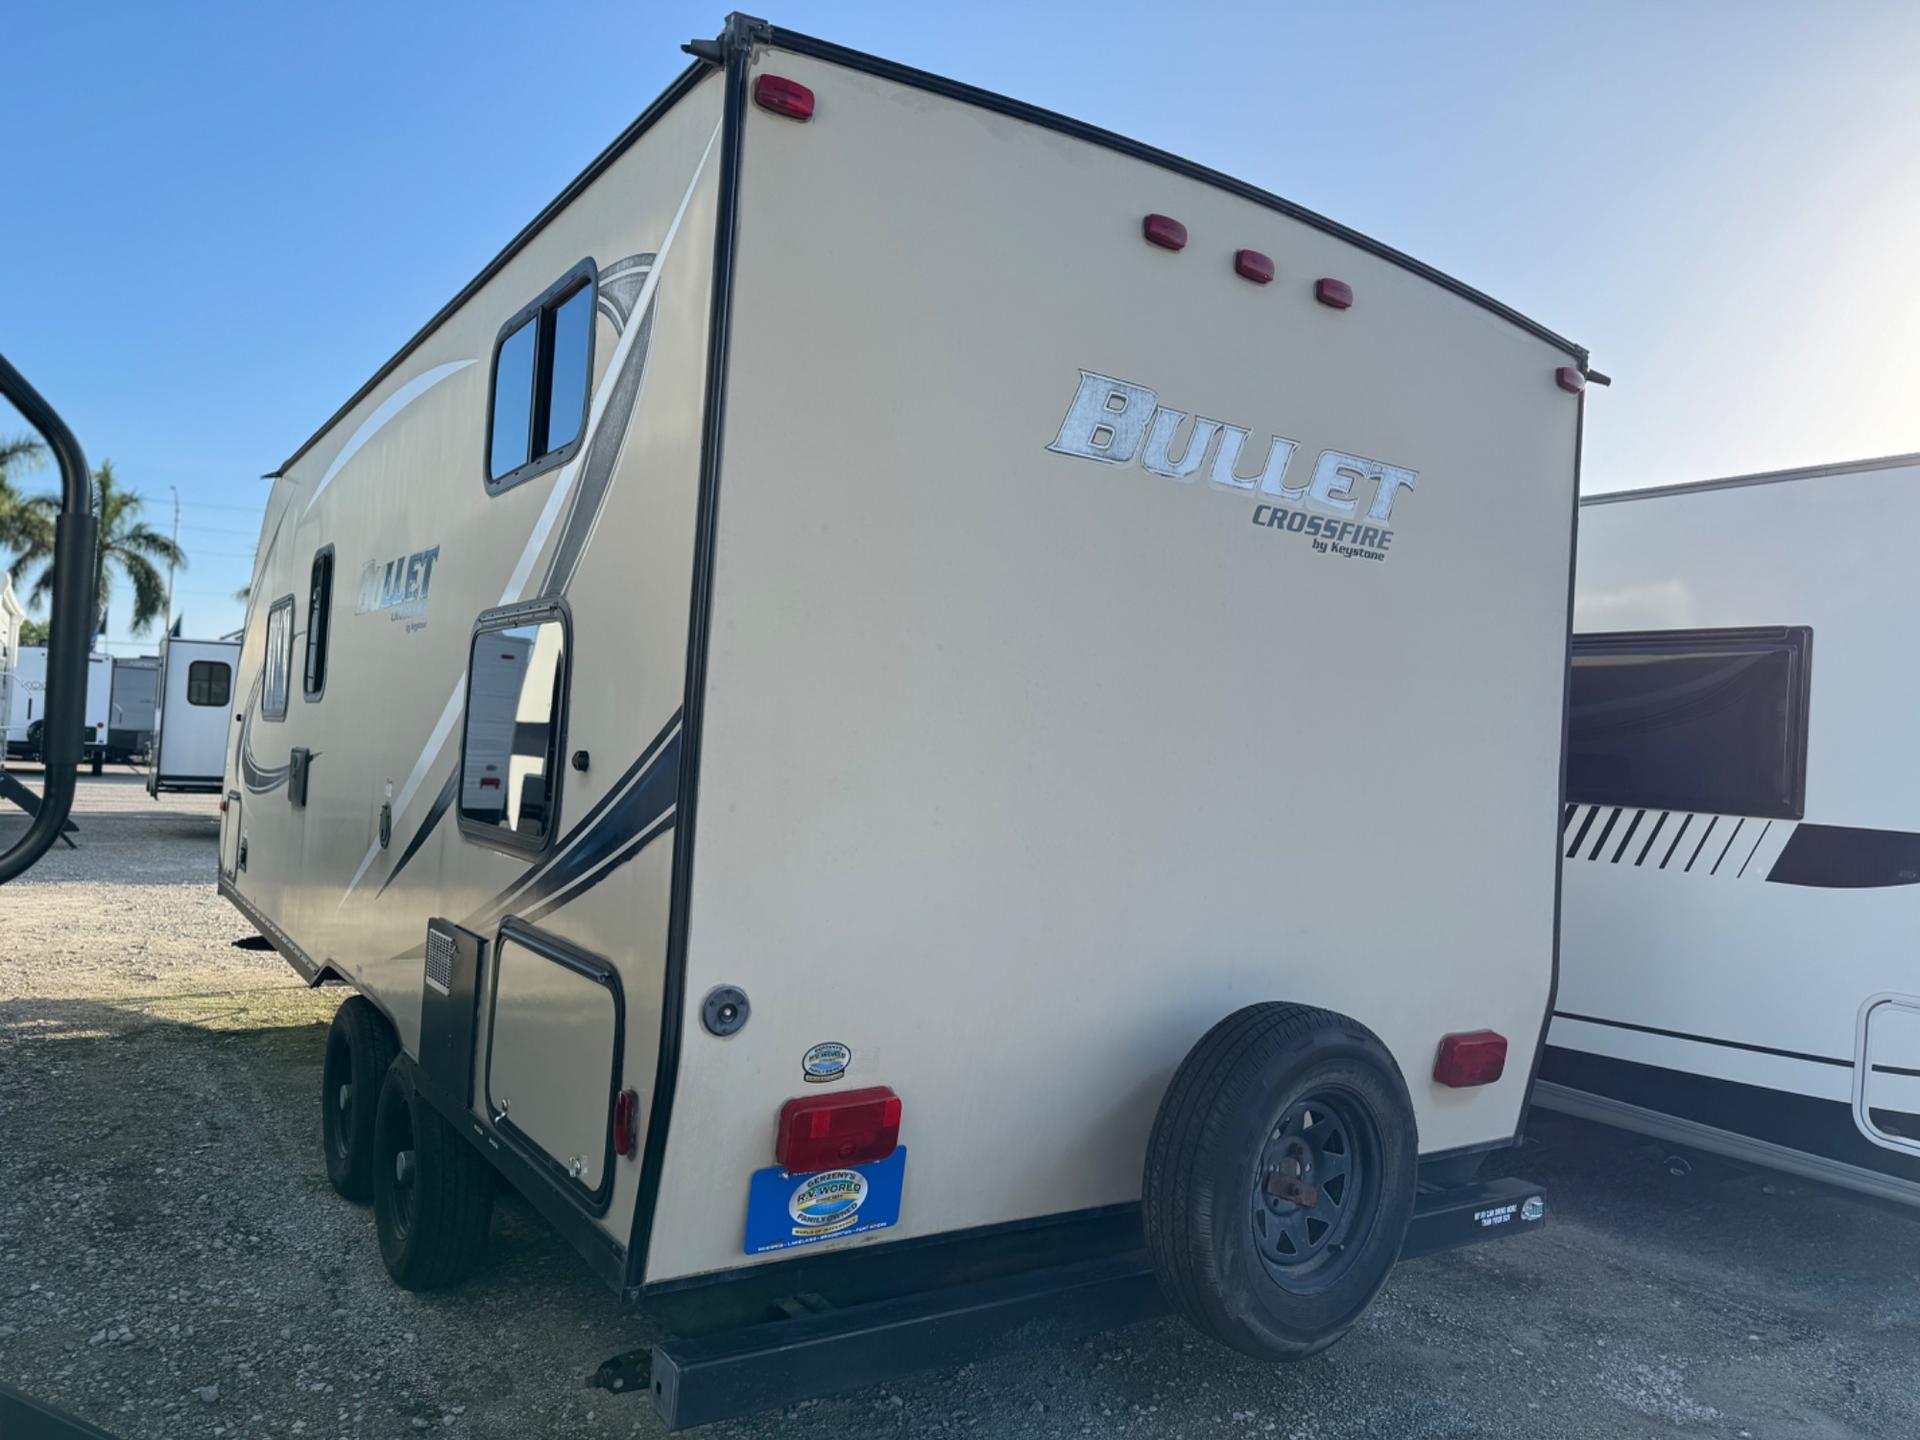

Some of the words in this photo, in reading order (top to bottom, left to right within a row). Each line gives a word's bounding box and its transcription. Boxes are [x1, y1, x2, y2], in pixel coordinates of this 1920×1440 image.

[1044, 367, 1419, 525] BULLET
[1252, 504, 1394, 551] CROSSFIRE
[1312, 538, 1328, 554] by
[1330, 541, 1385, 562] Keystone
[819, 1183, 862, 1196] WORLD
[796, 1212, 827, 1224] FAMILY
